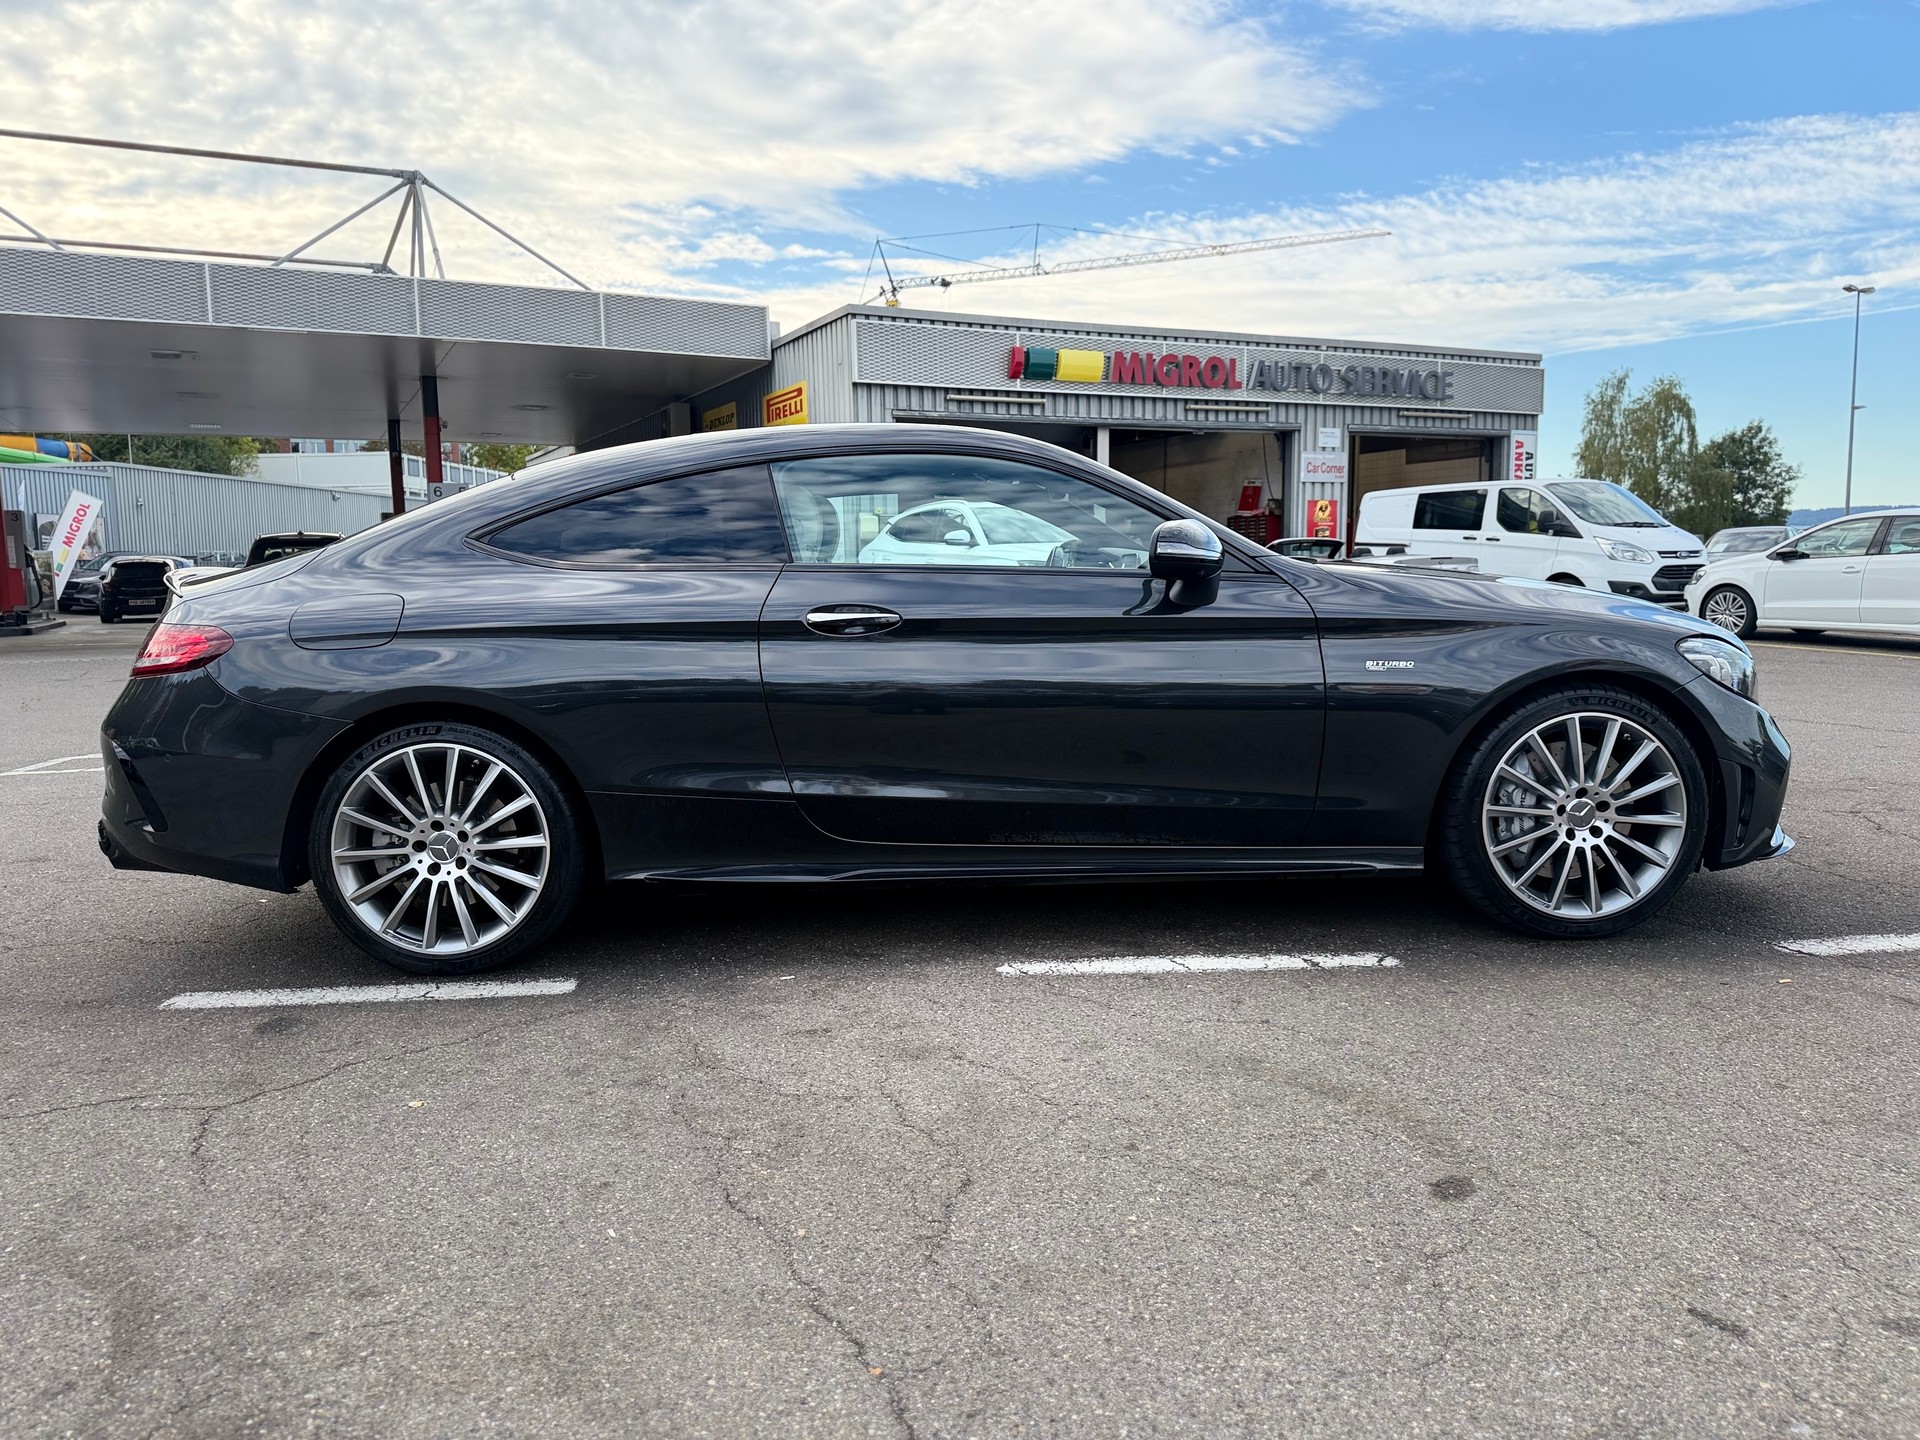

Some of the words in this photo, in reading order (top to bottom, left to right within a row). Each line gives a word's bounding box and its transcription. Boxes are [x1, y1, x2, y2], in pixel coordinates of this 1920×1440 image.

[1111, 351, 1242, 389] MIGROL
[1247, 359, 1334, 394] AUTO
[1340, 364, 1455, 400] SERVICE
[766, 387, 803, 424] PIRELLI
[709, 412, 735, 430] DUNLOP
[1306, 462, 1320, 473] Car
[1320, 462, 1345, 474] Corner
[433, 486, 443, 498] 6
[11, 513, 19, 522] 3
[62, 503, 91, 548] MIGROL
[1365, 660, 1415, 668] BITURBO
[1587, 696, 1656, 724] MICHELIN
[362, 725, 438, 760] MICHELIN
